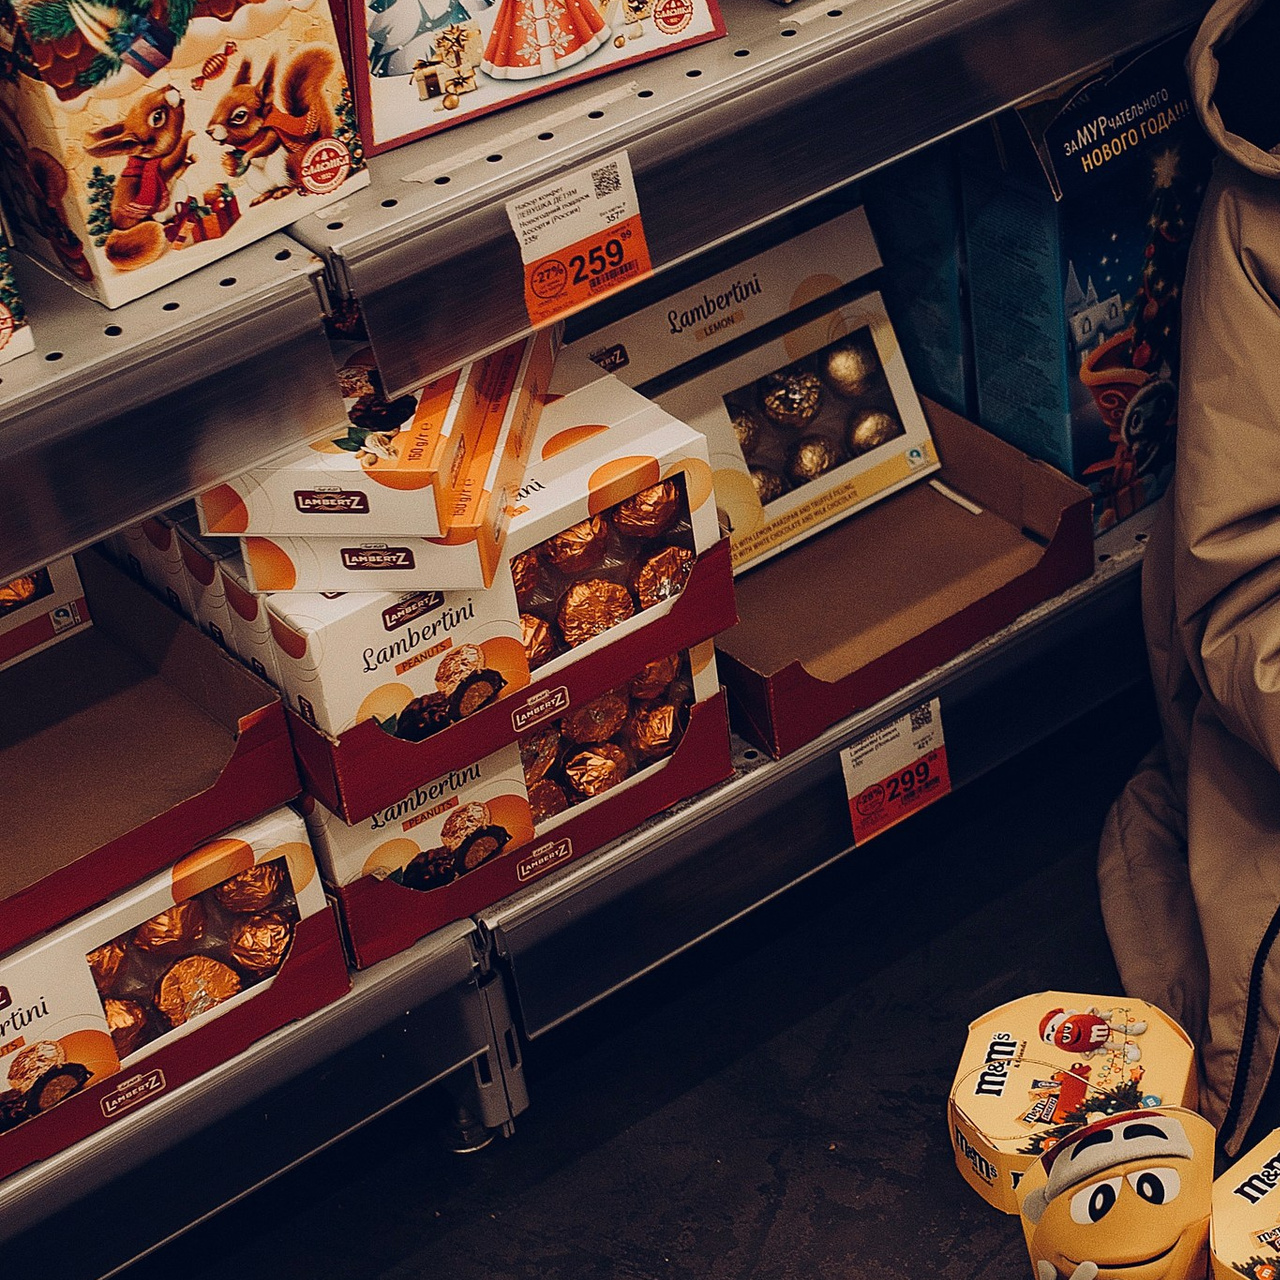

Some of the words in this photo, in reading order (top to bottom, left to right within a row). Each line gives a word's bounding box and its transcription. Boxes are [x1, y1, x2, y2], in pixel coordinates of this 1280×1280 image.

[1081, 128, 1138, 173] НОВОГО
[515, 198, 537, 210] Набор
[538, 187, 563, 202] конфет
[520, 206, 560, 227] Новогодний
[562, 194, 590, 209] подарок
[552, 189, 577, 205] ДЕТЯМ
[522, 221, 550, 237] Ассорти
[552, 206, 580, 223] (Россия)
[606, 212, 620, 224] 357
[533, 263, 564, 285] -27%
[569, 238, 624, 286] 259
[620, 229, 632, 241] 99
[667, 273, 762, 334] Lambertini
[703, 316, 735, 336] LEMON
[407, 442, 422, 462] 150
[297, 496, 364, 509] LAMBERTZ
[753, 526, 772, 539] LEMON
[344, 552, 409, 566] LAMBERTZ
[385, 592, 440, 628] LAMBERTZ
[363, 598, 475, 674] Lambertini
[401, 643, 447, 671] PEANUTS
[515, 693, 565, 726] LAMBERTZ
[886, 761, 930, 803] 299
[408, 800, 452, 828] PEANUTS
[521, 845, 568, 876] LAMBERTZ
[105, 1077, 161, 1112] LAMBERTZ
